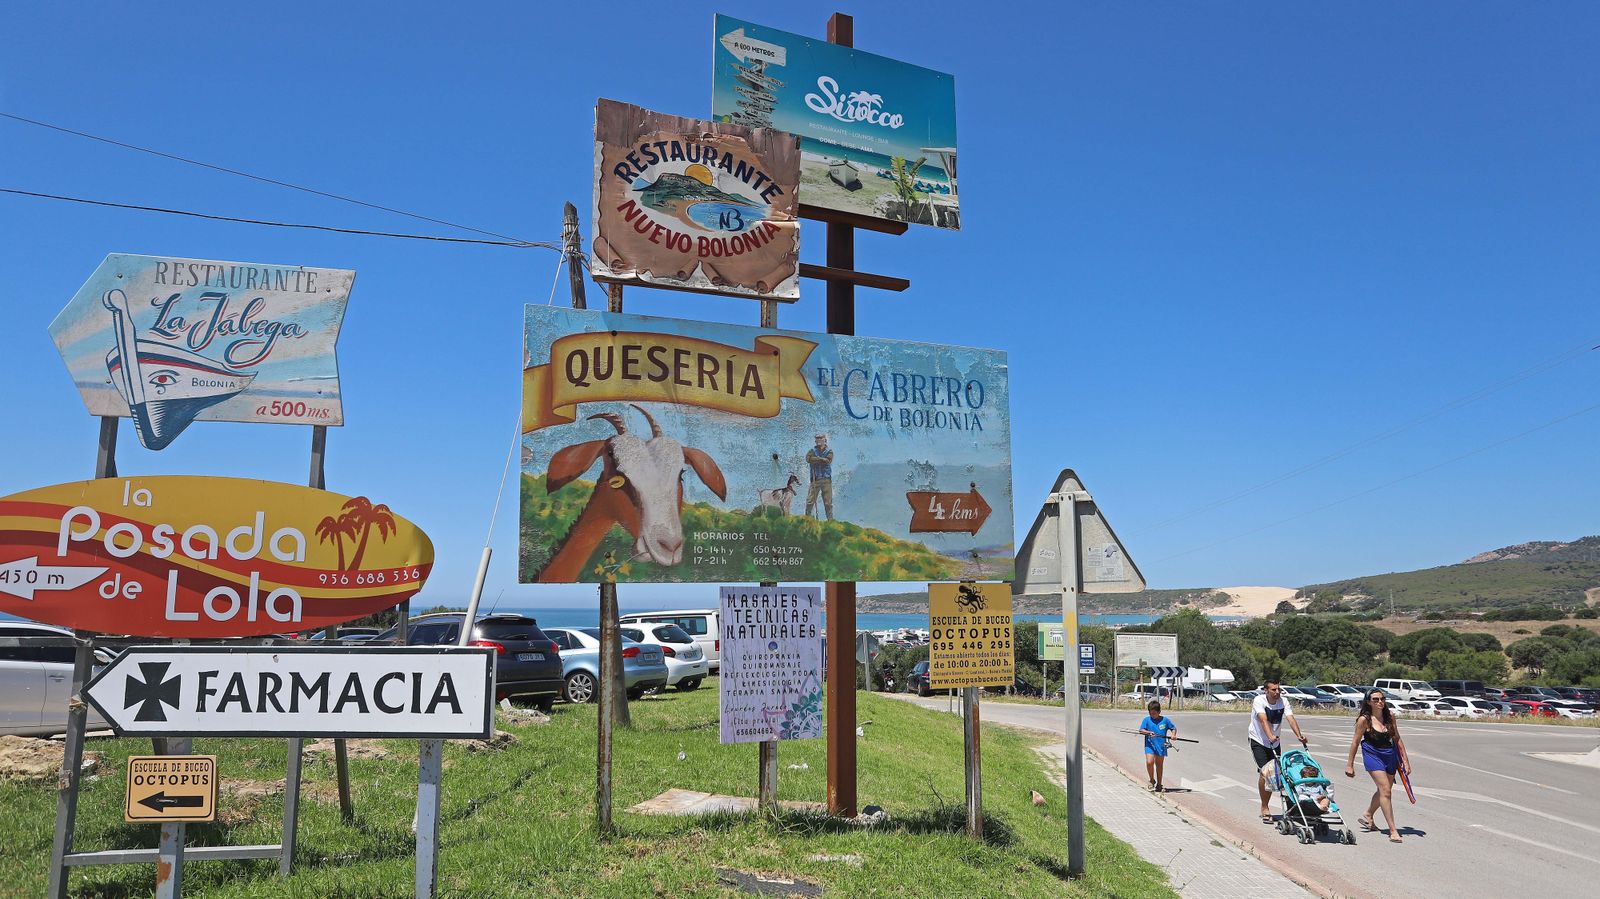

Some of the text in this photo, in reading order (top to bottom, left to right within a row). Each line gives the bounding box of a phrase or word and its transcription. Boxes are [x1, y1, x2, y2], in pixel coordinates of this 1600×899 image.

[752, 46, 775, 57] METROS
[804, 75, 905, 129] Sirocco
[614, 140, 785, 205] RESTAURANTE
[616, 200, 692, 254] NUEVO
[154, 261, 318, 294] RESTAURANTE
[149, 291, 309, 369] La Jábega
[564, 344, 765, 400] QUESERÍA
[191, 376, 236, 389] BOLONIA
[816, 366, 985, 421] EL CABRERO
[256, 405, 268, 417] a
[872, 404, 984, 433] DE BOLONIA
[122, 480, 153, 507] la
[928, 495, 978, 520] 4 kms
[57, 506, 307, 563] Posada
[693, 531, 745, 541] HORARIOS
[753, 545, 770, 554] 650
[753, 557, 804, 566] 662 564 867
[47, 573, 65, 585] m
[318, 568, 420, 585] 956 688 536
[98, 569, 303, 623] de Lola
[727, 593, 814, 608] MASAJES Y
[932, 615, 1011, 626] ESCUELA DE BUCEO
[726, 624, 816, 639] NATURALES
[932, 627, 1010, 640] OCTOPUS
[932, 640, 1011, 651] 695 446 295
[742, 653, 801, 661] QUIROPRAXIA
[742, 661, 801, 669] QUIROMASAJE
[934, 661, 945, 669] de
[947, 660, 969, 669] 10:00
[979, 659, 1001, 668] 20:00
[931, 676, 1013, 685] www.octopusbuceo.com
[195, 670, 463, 715] FARMACIA
[726, 689, 765, 697] TERAPIA
[134, 762, 210, 773] ESCUELA DE BUCEO
[134, 774, 209, 786] OCTOPUS
